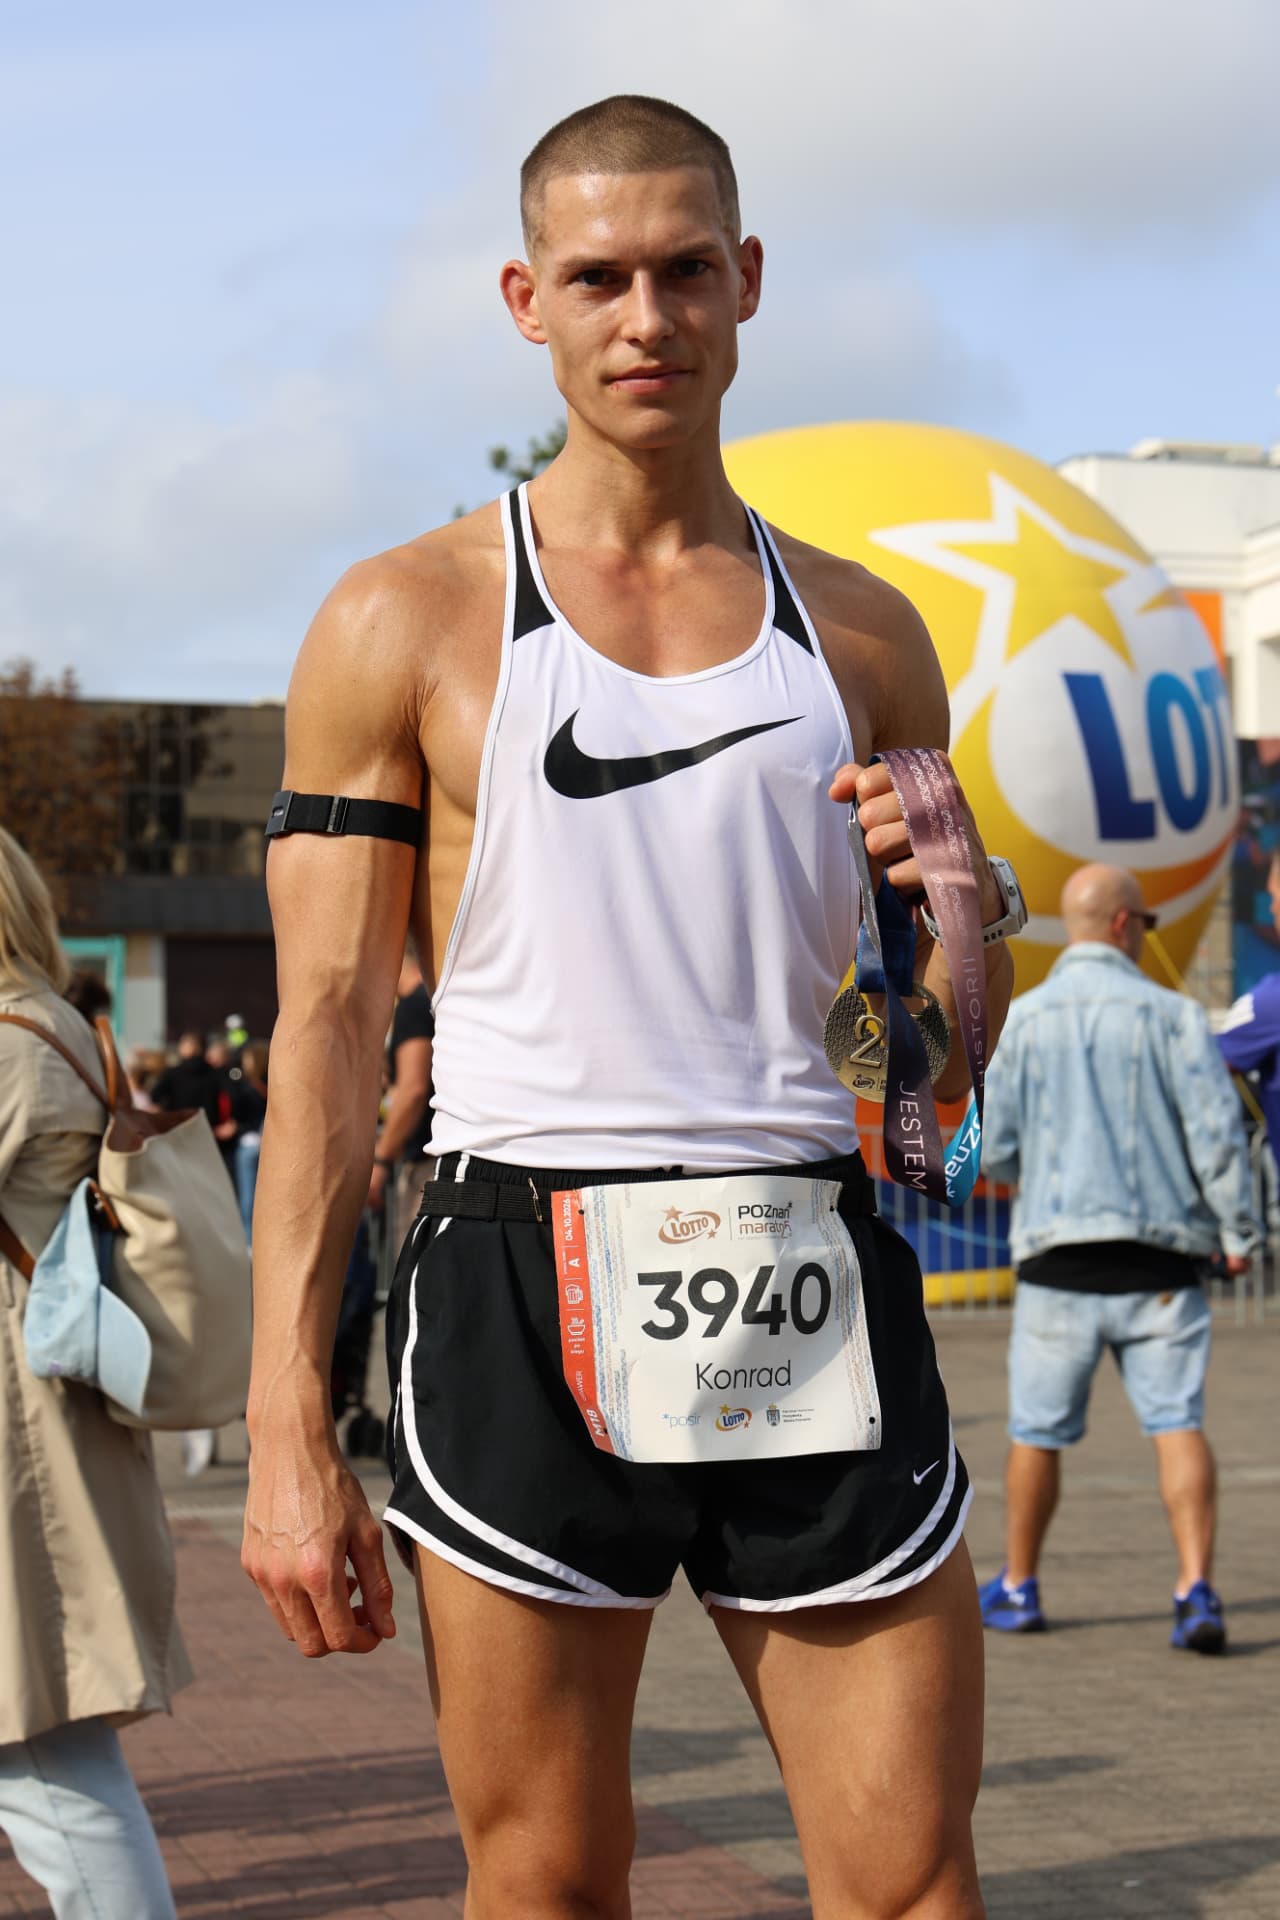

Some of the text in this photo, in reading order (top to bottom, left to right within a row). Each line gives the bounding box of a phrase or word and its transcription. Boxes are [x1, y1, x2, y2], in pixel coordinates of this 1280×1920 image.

[961, 956, 985, 1087] HISTORII
[899, 1080, 928, 1190] JESTEM
[670, 1217, 709, 1238] LOTTO
[568, 1257, 580, 1268] A
[637, 1262, 832, 1341] 3940
[696, 1359, 791, 1391] Konrad
[586, 1408, 605, 1437] M18
[722, 1412, 745, 1427] LOTTO
